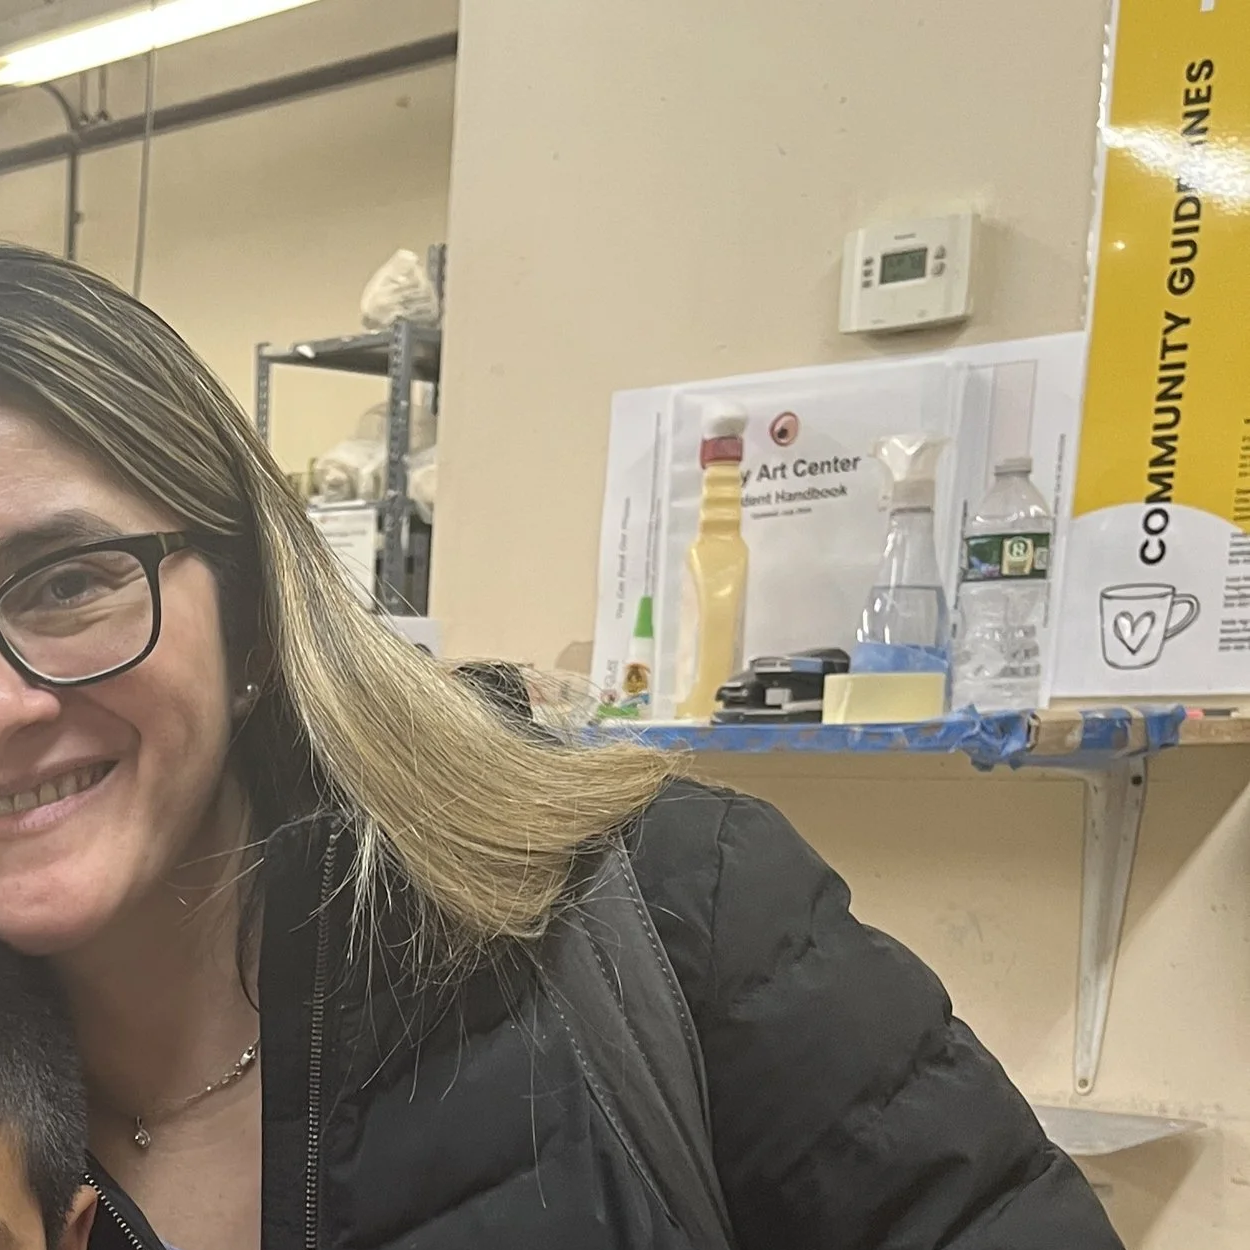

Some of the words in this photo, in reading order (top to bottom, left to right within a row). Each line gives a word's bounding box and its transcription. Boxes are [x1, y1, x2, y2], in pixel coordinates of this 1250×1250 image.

[1139, 310, 1191, 565] COMMUNITY
[1167, 59, 1214, 296] GUIDINES
[756, 462, 787, 481] Art
[792, 456, 861, 478] Center
